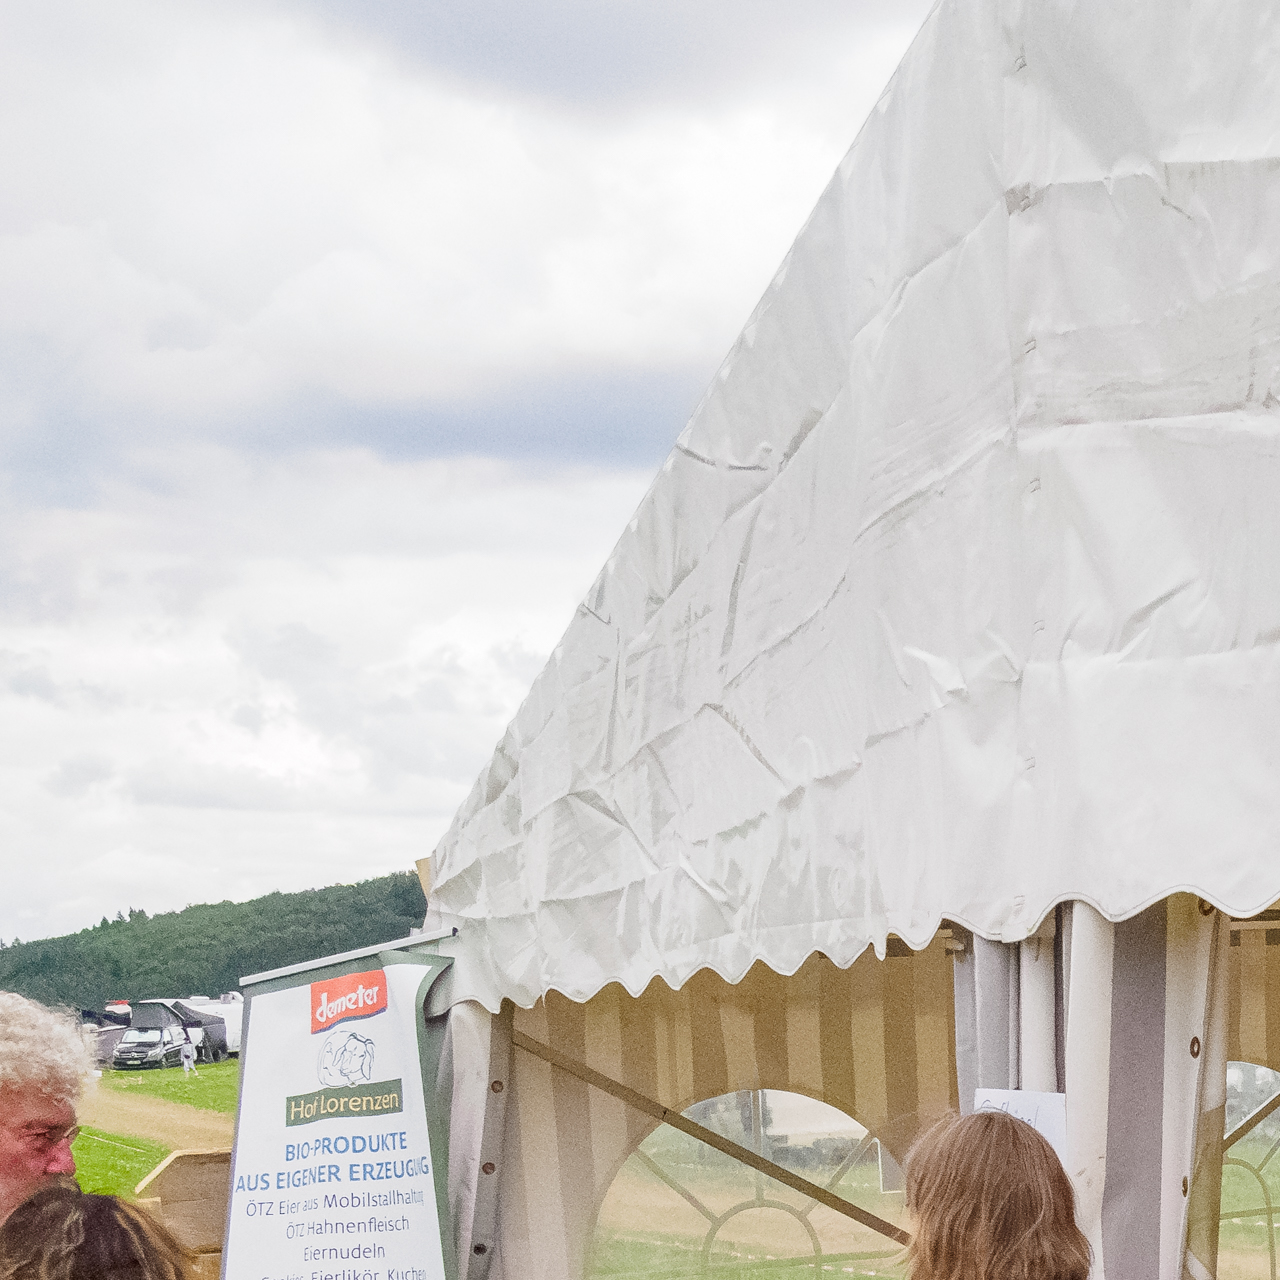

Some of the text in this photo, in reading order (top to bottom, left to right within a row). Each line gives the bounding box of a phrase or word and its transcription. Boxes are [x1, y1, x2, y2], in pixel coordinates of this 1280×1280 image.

[315, 982, 380, 1023] demeter
[290, 1093, 399, 1121] Hof Lorenzen
[285, 1131, 408, 1162] BIO-PRODUKTE
[235, 1173, 270, 1193] AUS
[276, 1164, 342, 1190] EIGENER
[246, 1189, 424, 1217] ÖTZ Eier aus Mobilstallhalt
[286, 1215, 410, 1240] ÖTZ Hahnenfleisch
[303, 1242, 386, 1262] Eiernudeln
